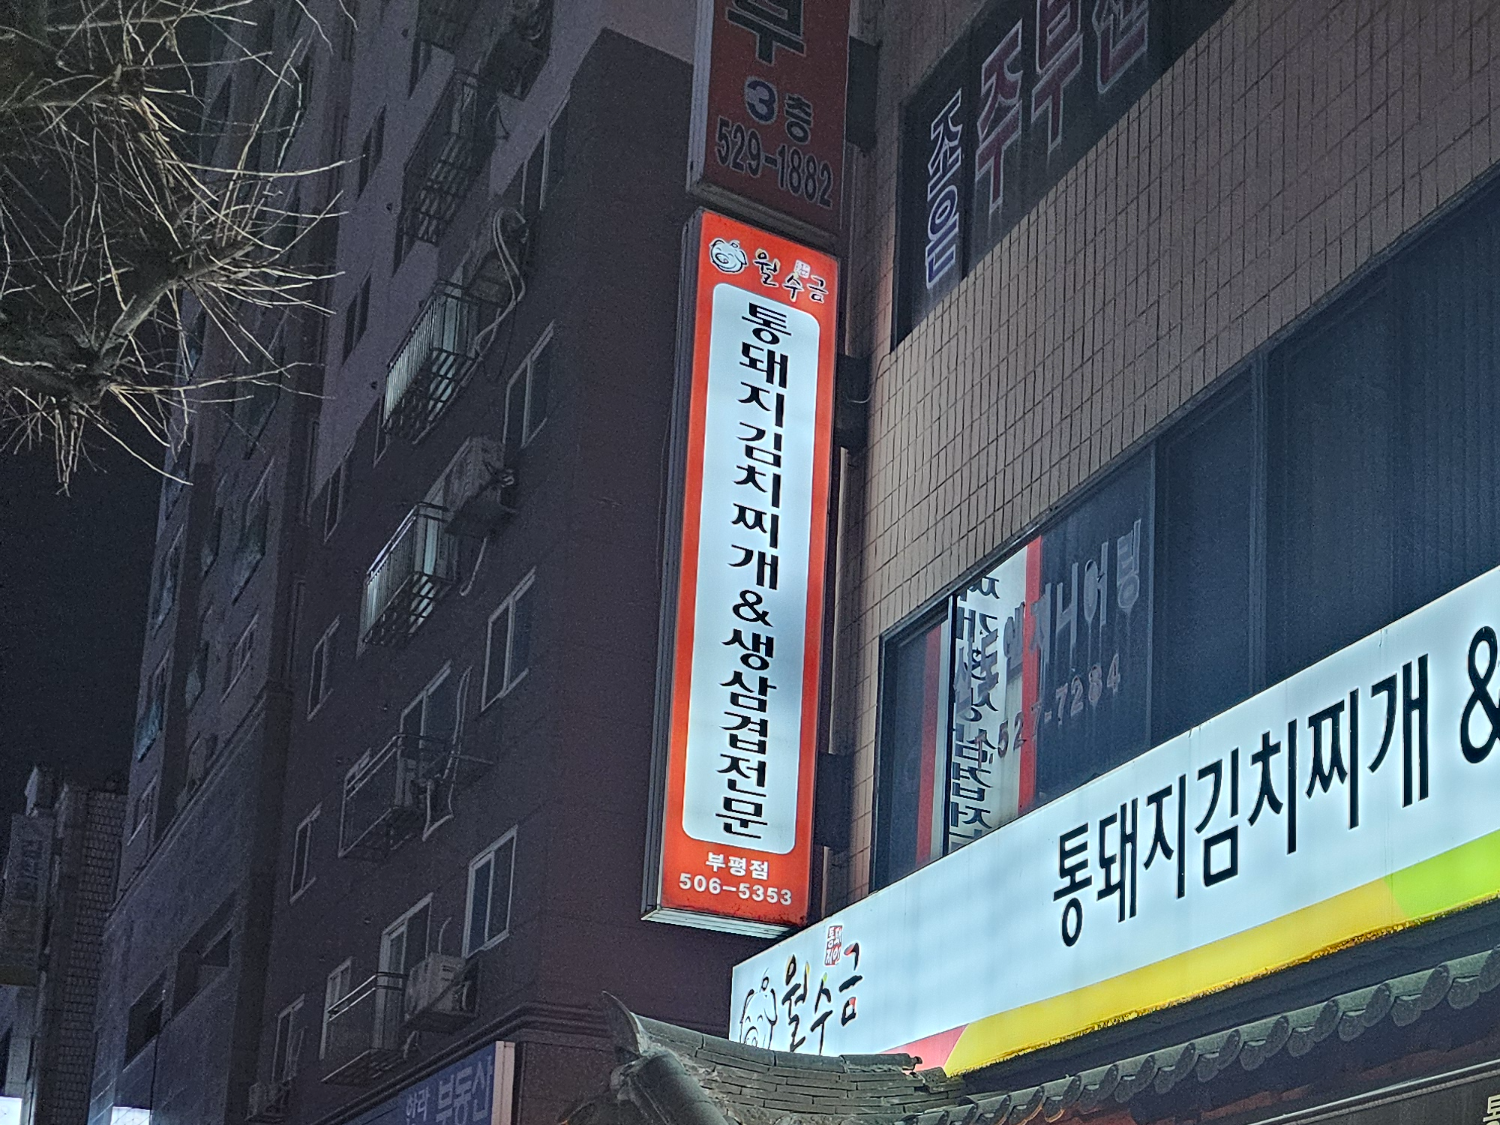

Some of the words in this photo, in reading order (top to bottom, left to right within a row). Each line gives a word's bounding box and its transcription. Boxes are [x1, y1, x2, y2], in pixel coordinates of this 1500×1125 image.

[744, 75, 814, 144] 3층
[715, 117, 834, 209] 529-1882
[753, 249, 829, 303] 월수금
[715, 301, 793, 840] 통돼지김치찌개&생삼겹전문
[1053, 653, 1430, 947] 통돼지김치찌개
[678, 872, 793, 906] 506-5353
[706, 852, 769, 881] 부평점
[781, 942, 863, 1056] 월수금
